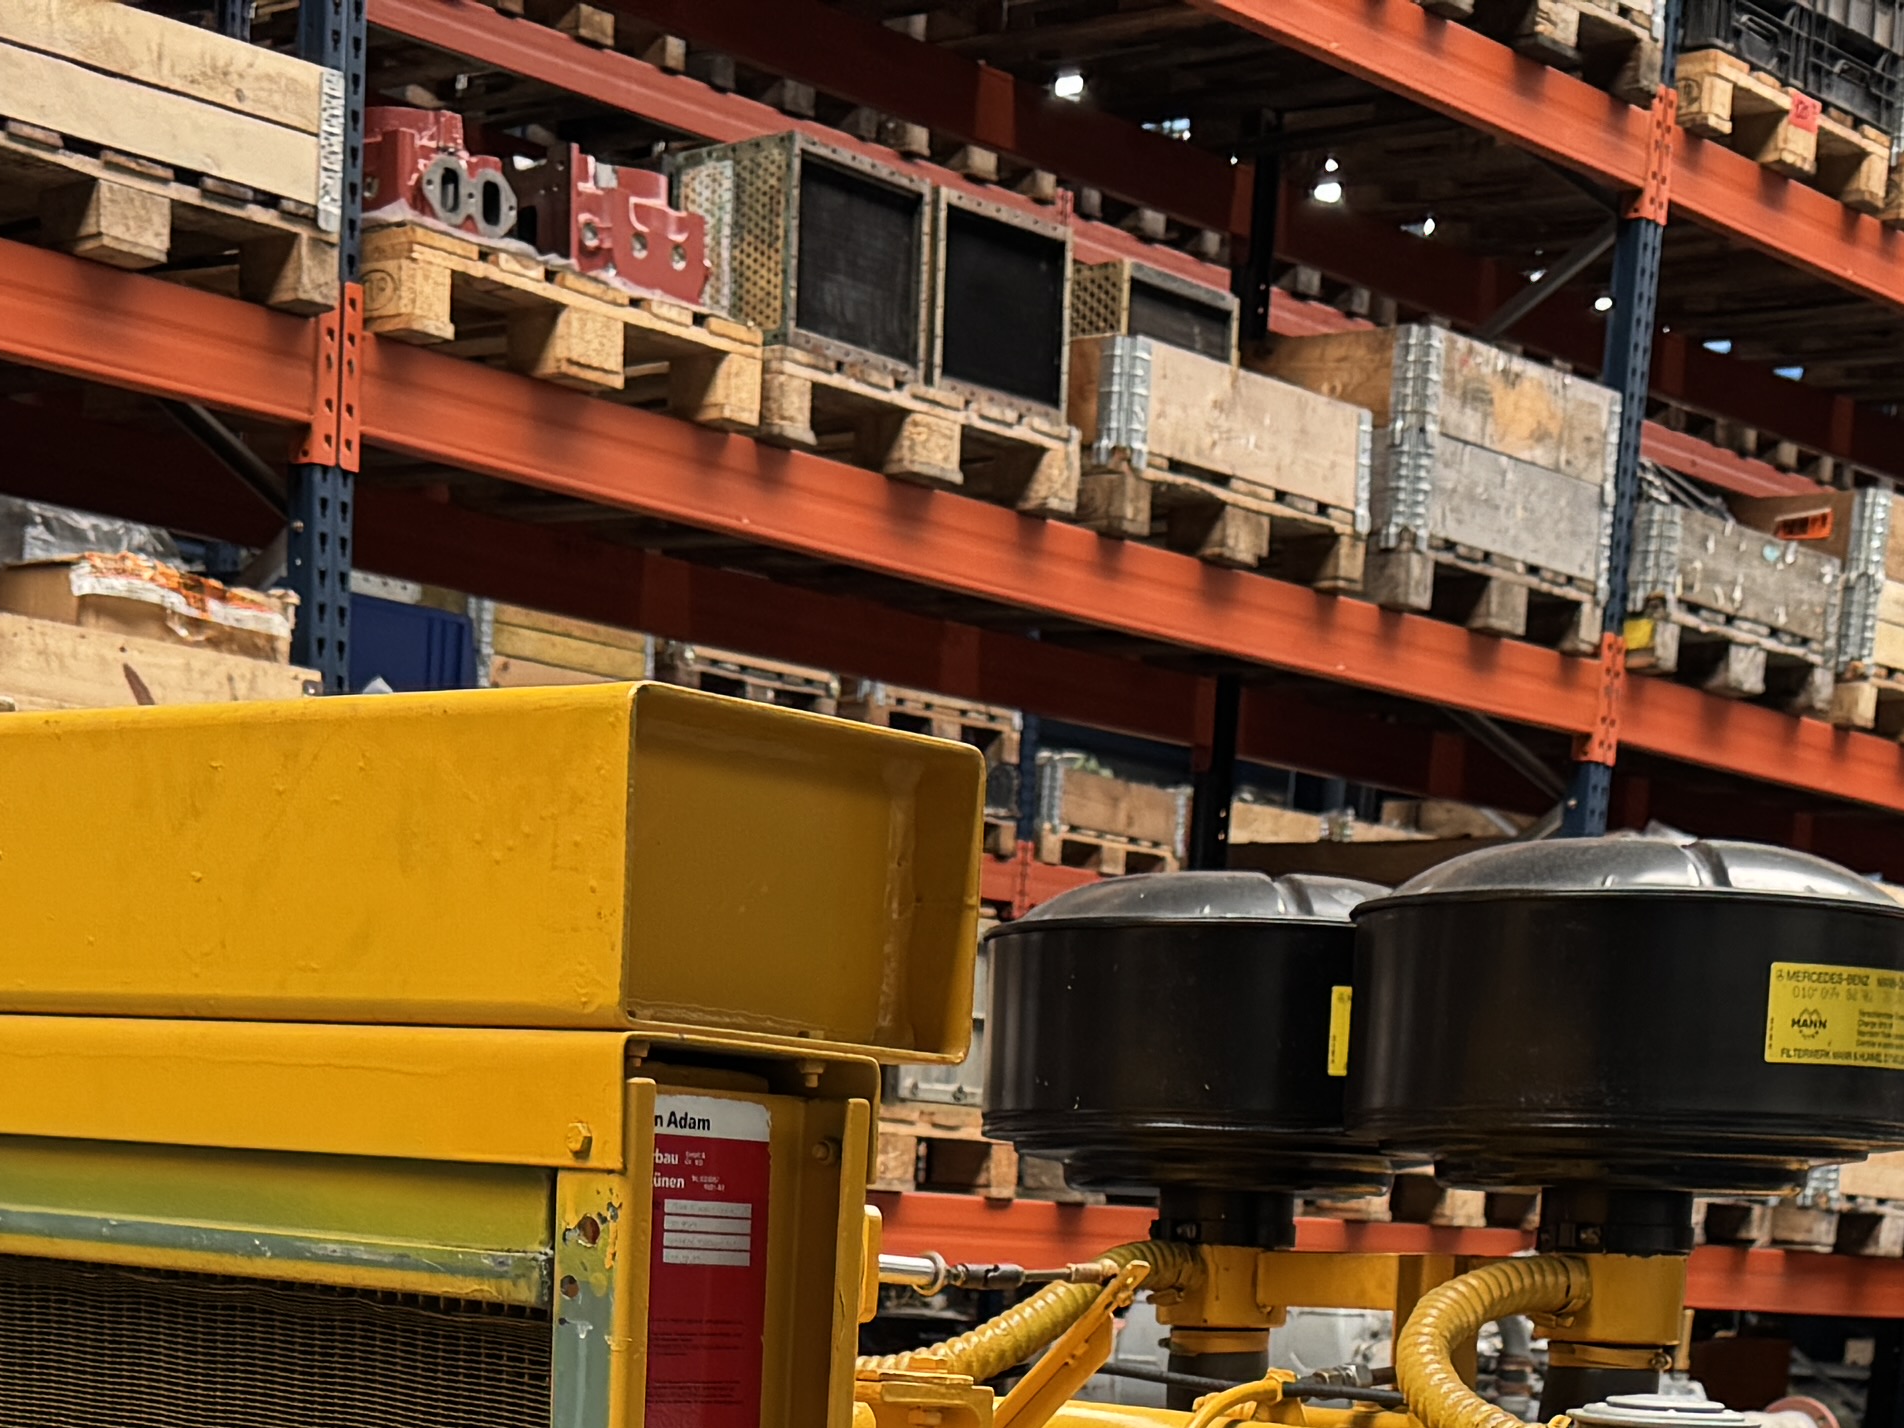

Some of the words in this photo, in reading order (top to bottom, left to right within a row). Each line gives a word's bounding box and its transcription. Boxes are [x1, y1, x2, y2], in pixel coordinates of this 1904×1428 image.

[1786, 970, 1871, 987] MERCEDES-BENZ
[1791, 1018, 1828, 1030] MANN
[667, 1111, 711, 1131] Adam
[653, 1149, 679, 1165] bau
[653, 1172, 685, 1189] ünen
